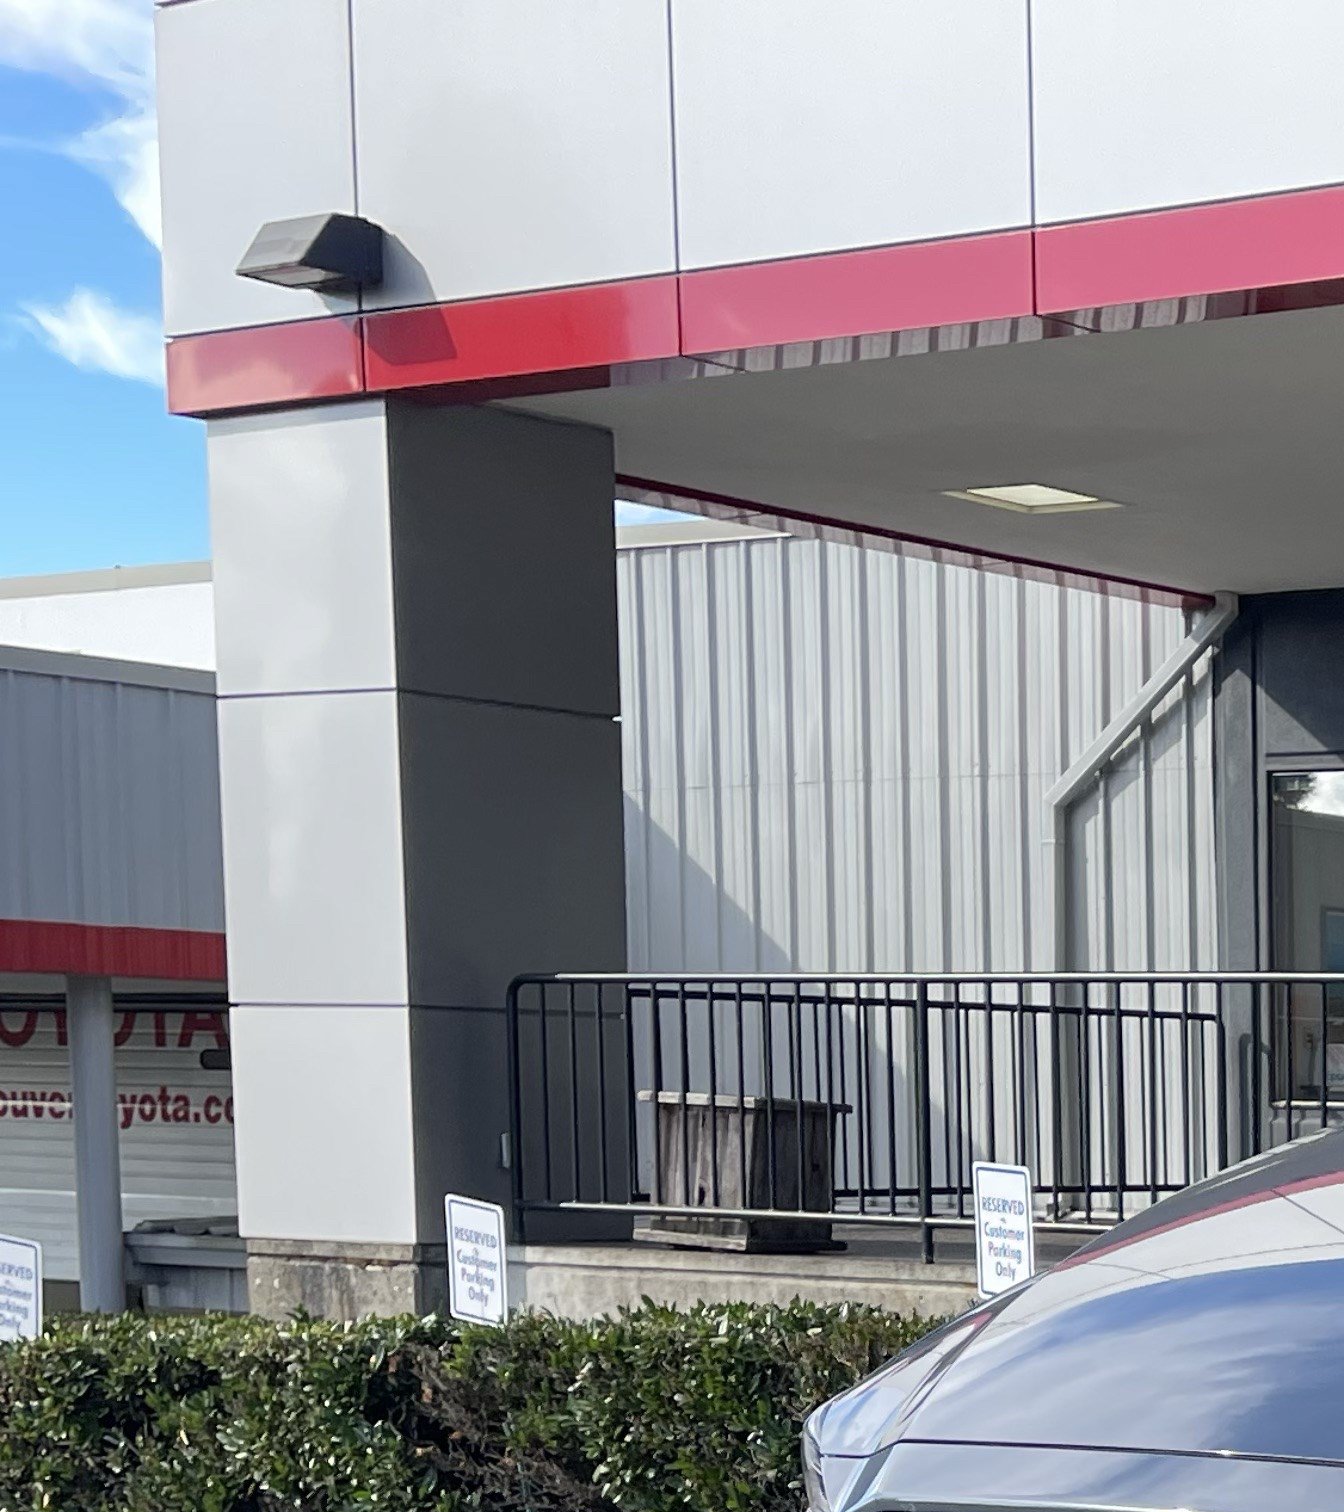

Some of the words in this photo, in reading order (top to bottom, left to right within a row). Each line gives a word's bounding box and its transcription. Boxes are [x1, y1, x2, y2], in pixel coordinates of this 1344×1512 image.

[982, 1196, 1025, 1216] RESERVED
[454, 1226, 498, 1249] RESERVED
[984, 1221, 1025, 1241] Customer
[456, 1248, 498, 1272] Customer
[987, 1240, 1022, 1264] Parking
[461, 1266, 495, 1292] Parking
[995, 1261, 1016, 1281] Only
[468, 1286, 489, 1307] Only
